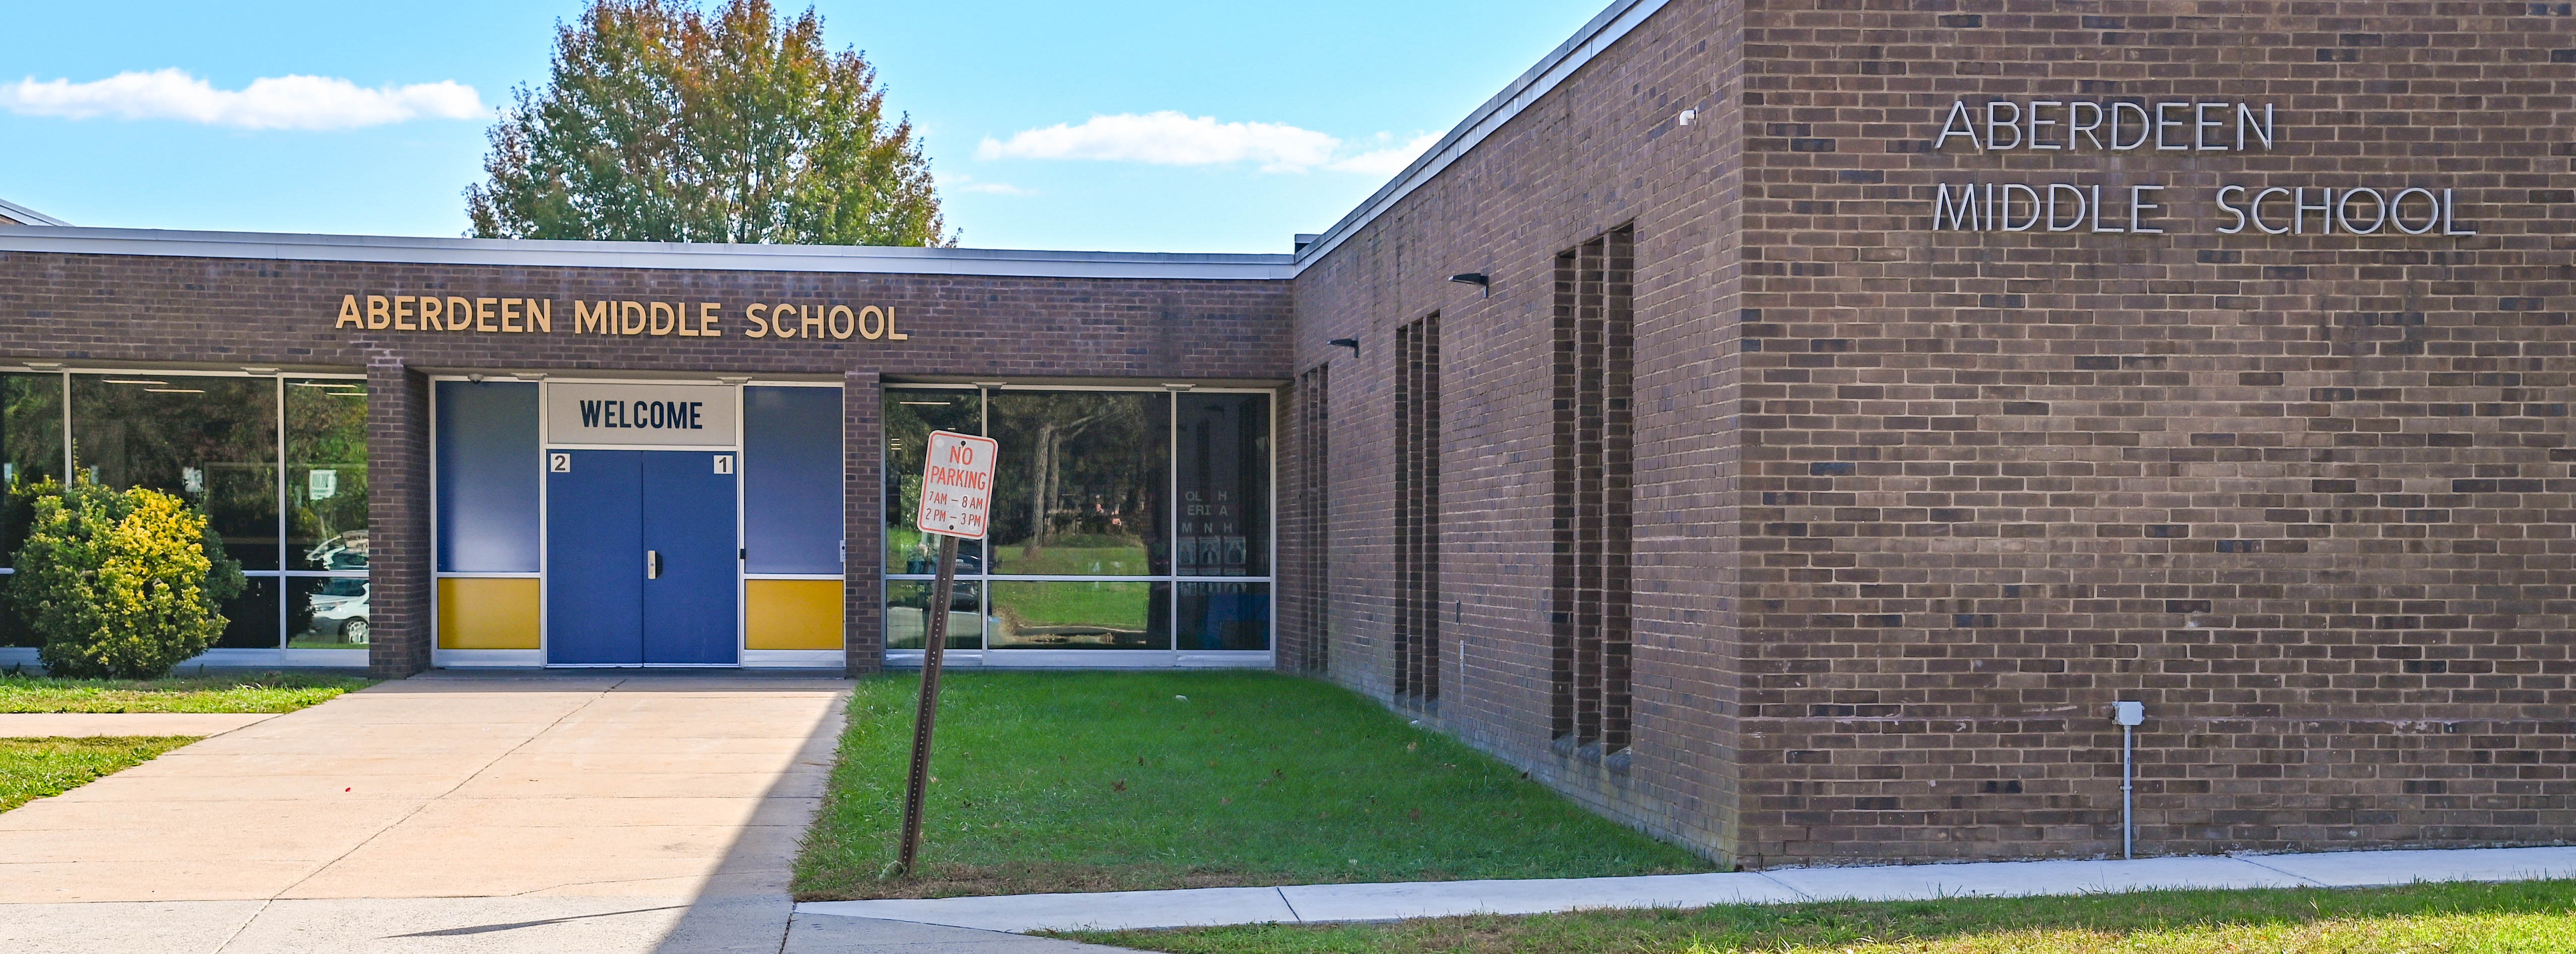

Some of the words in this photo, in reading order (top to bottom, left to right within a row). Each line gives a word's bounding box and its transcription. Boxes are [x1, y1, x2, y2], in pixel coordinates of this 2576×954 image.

[1934, 100, 2274, 151] ABERDEEN
[1931, 182, 2165, 235] MIDDLE
[2215, 185, 2477, 236] SCHOOL
[335, 294, 551, 333] ABERDEEN
[574, 299, 722, 337] MIDDLE
[744, 303, 908, 341] SCHOOL
[579, 400, 703, 430] WELCOME
[554, 455, 566, 471] 2
[718, 456, 727, 473] 1
[949, 445, 973, 465] NO
[930, 465, 987, 491] PARKING
[961, 496, 968, 508] 8
[969, 497, 983, 510] AM
[925, 508, 932, 520] 2
[933, 509, 946, 522] PM
[960, 513, 966, 525] 3
[968, 514, 981, 527] PM
